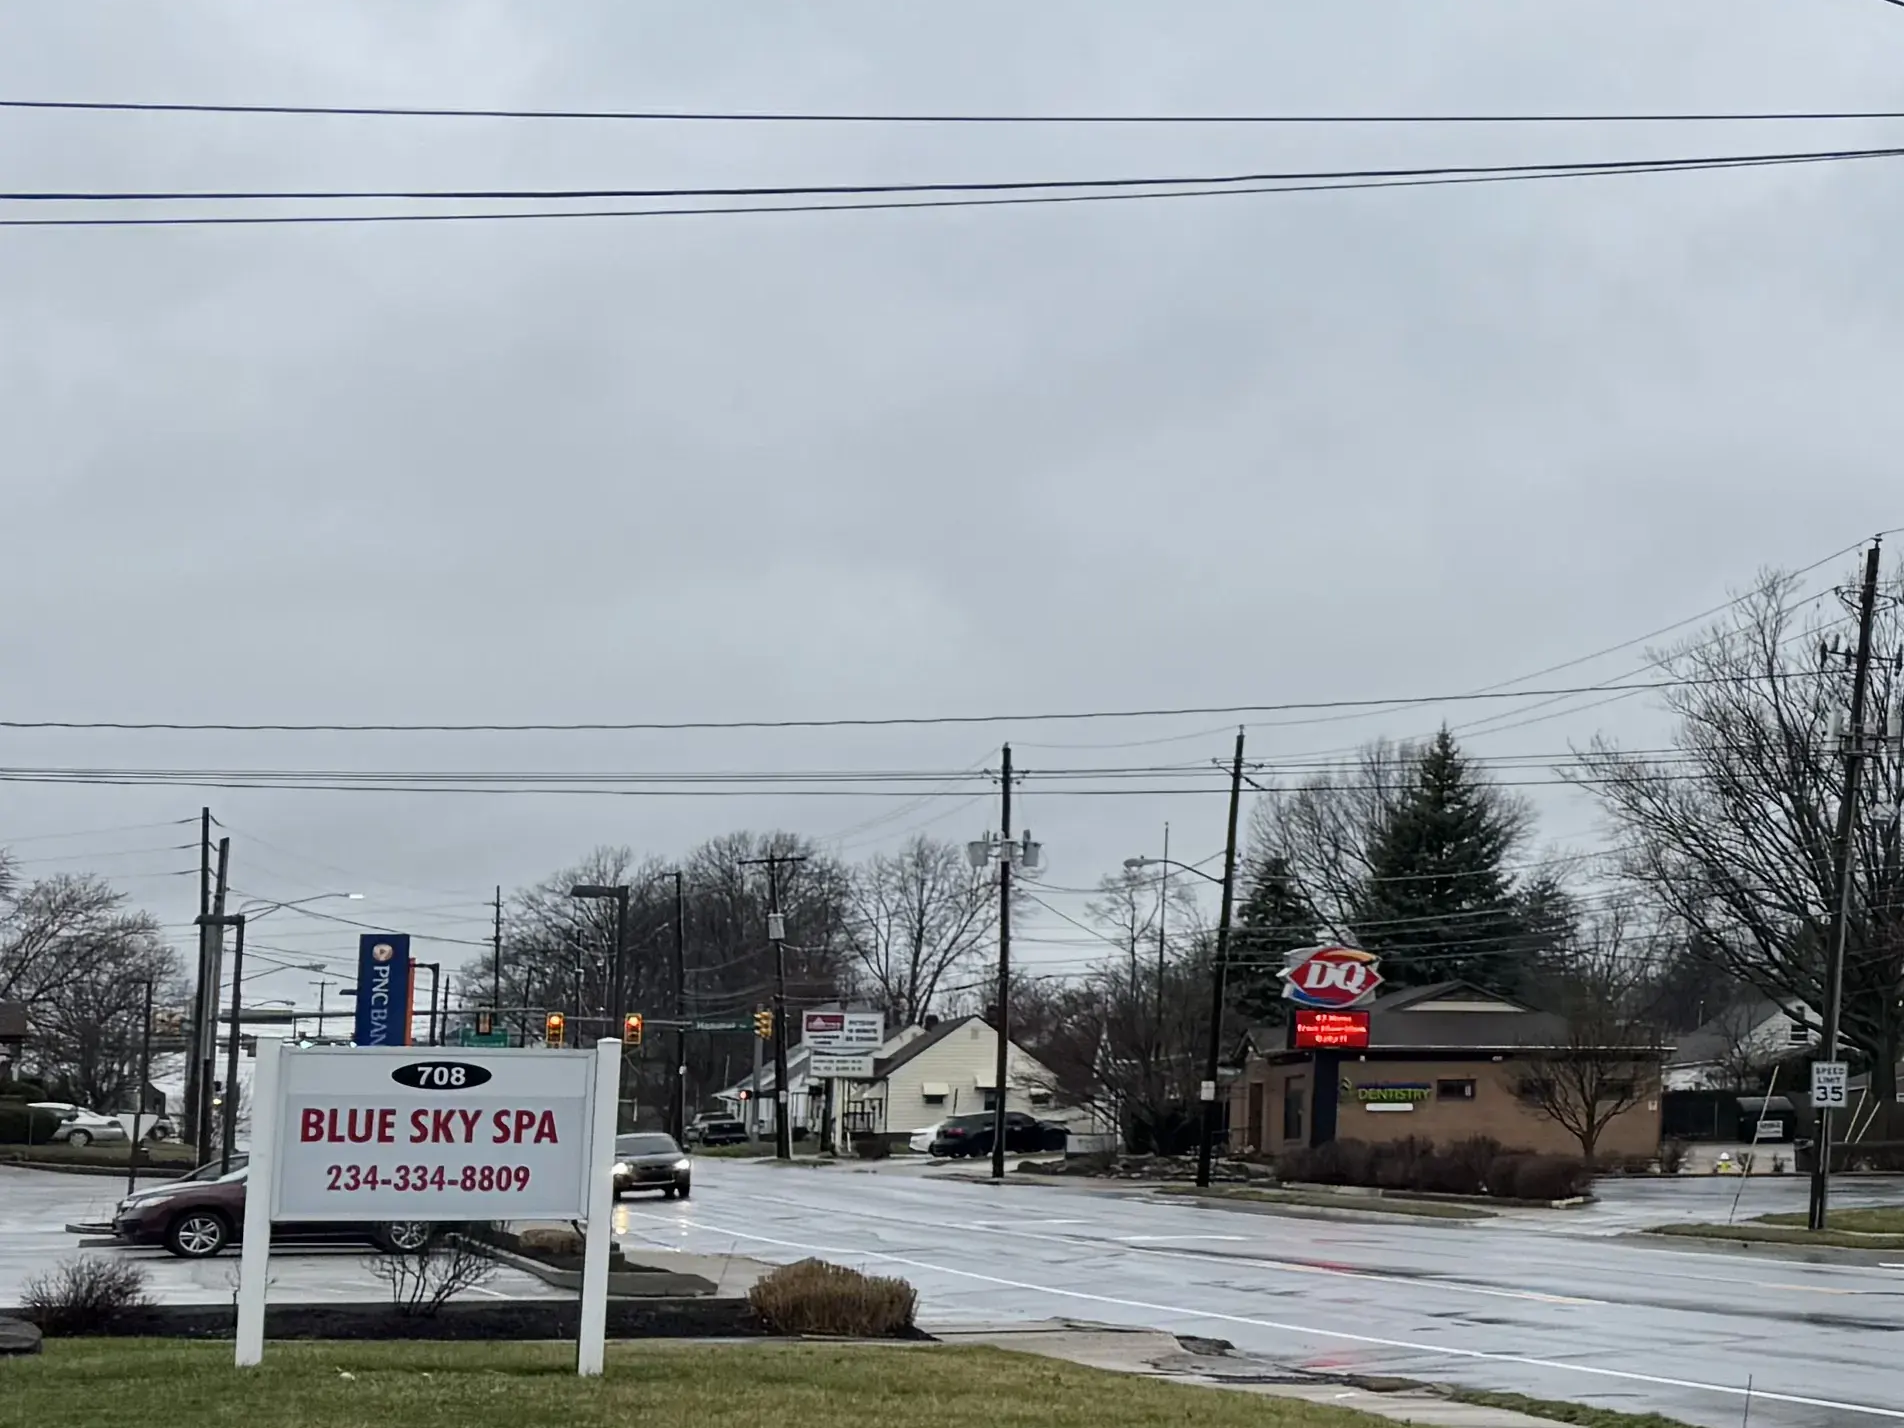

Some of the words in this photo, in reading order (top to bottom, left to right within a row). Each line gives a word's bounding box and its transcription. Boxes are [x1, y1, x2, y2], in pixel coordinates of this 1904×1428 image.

[371, 965, 390, 1006] PNC
[1303, 960, 1366, 995] DQ
[369, 1009, 388, 1046] BAN
[417, 1066, 466, 1086] 708
[1816, 1067, 1845, 1075] SPEED
[1358, 1088, 1431, 1101] DENTISTRY
[1816, 1086, 1843, 1102] 35
[300, 1108, 397, 1144] BLUE
[409, 1109, 482, 1145] SKY
[492, 1109, 559, 1145] SPA
[326, 1165, 530, 1192] 234-334-8809
